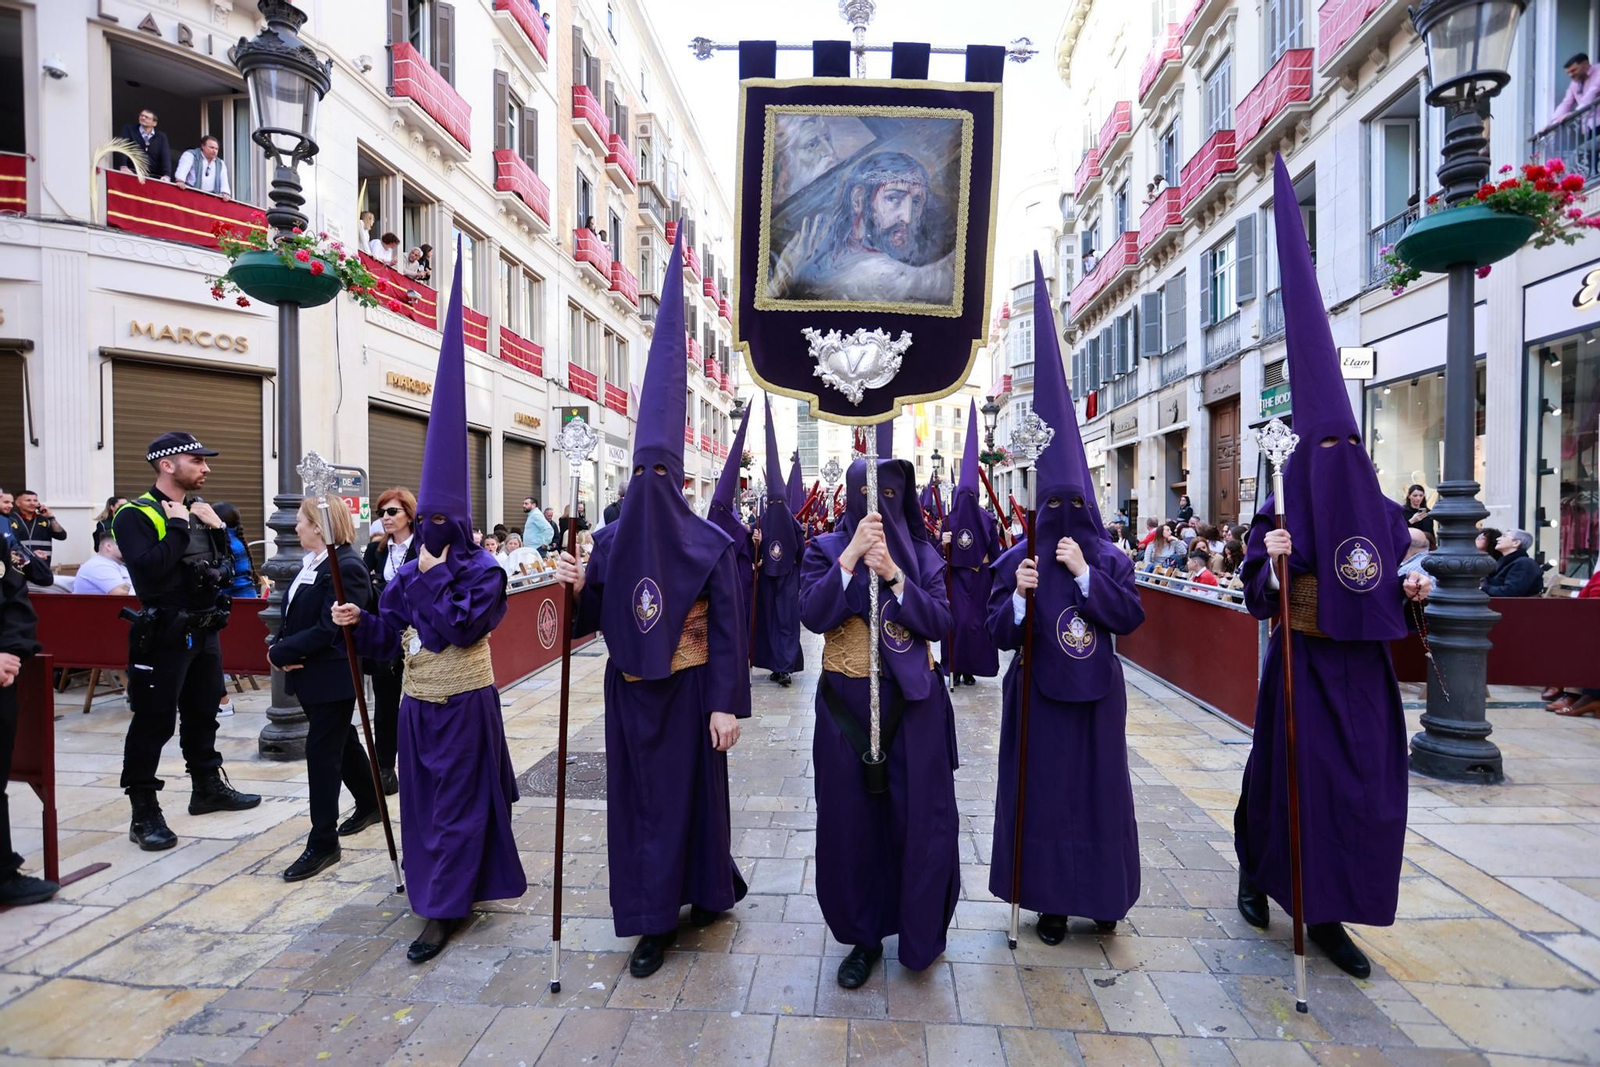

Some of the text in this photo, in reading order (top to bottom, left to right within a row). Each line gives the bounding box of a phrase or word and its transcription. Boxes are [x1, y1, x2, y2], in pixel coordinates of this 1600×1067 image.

[130, 319, 249, 353] MARCOS
[1343, 356, 1370, 366] Etam
[1262, 391, 1291, 409] THE BOD
[609, 446, 625, 460] KIKO
